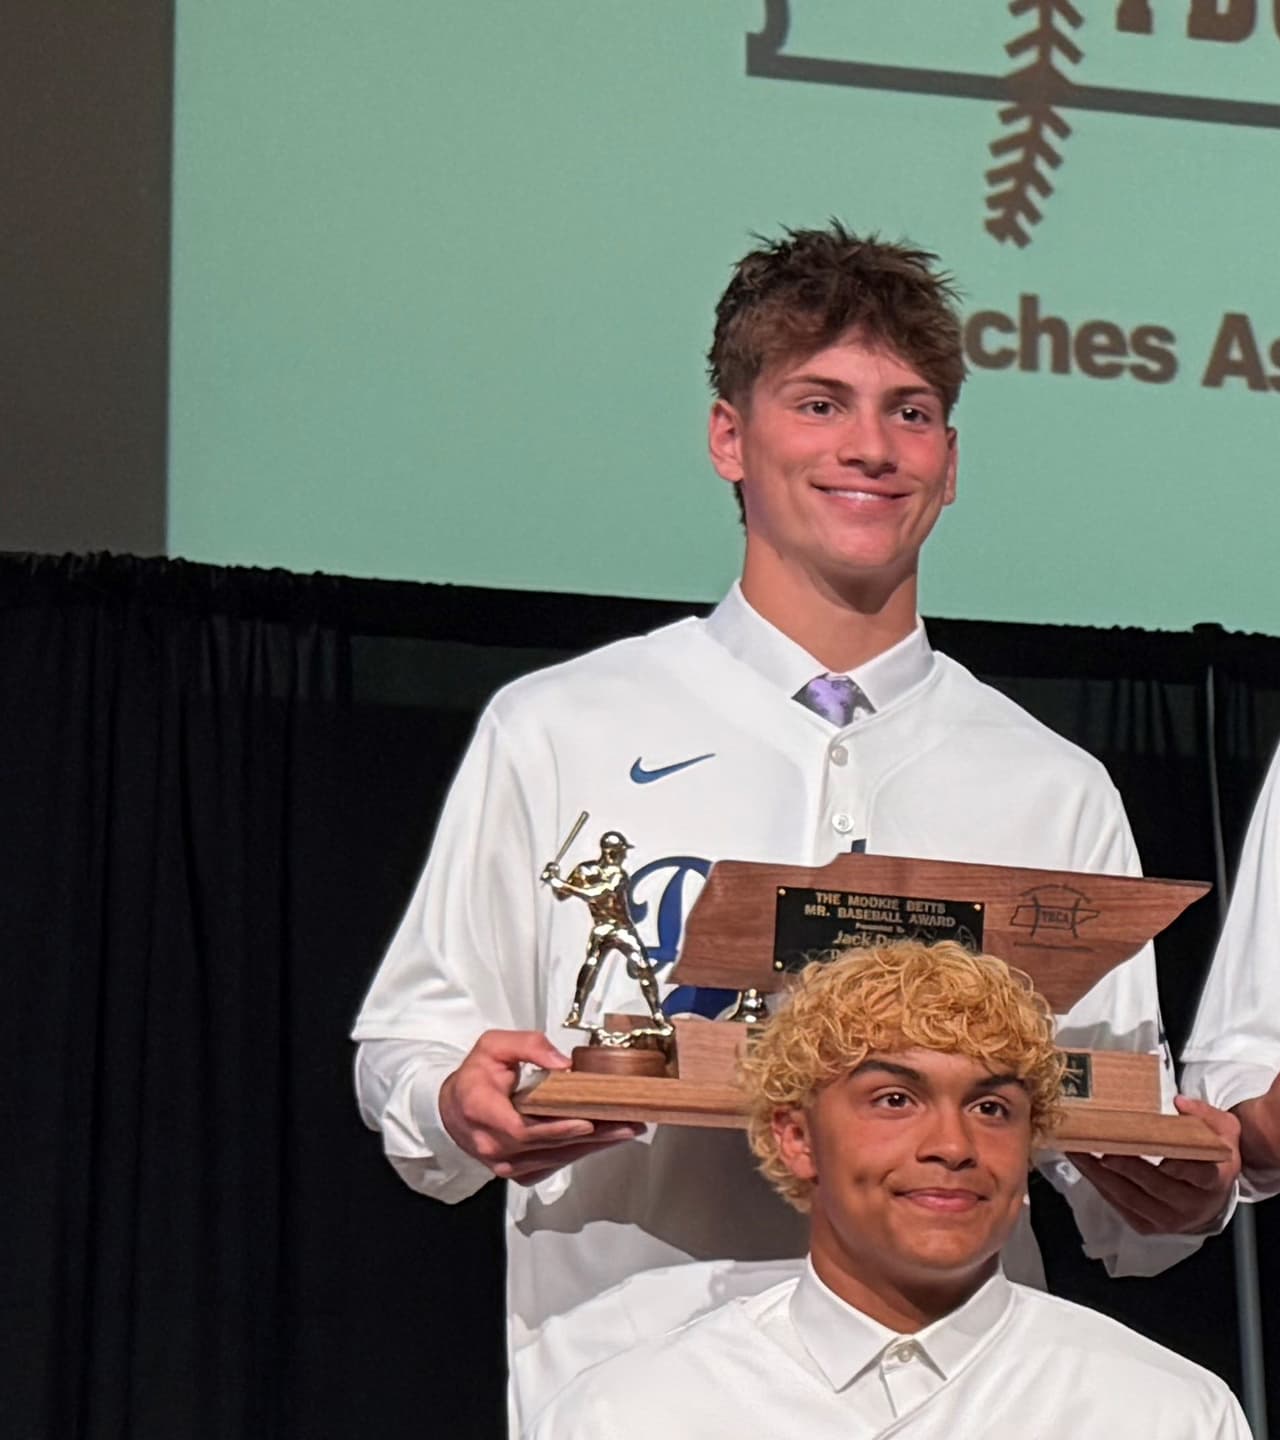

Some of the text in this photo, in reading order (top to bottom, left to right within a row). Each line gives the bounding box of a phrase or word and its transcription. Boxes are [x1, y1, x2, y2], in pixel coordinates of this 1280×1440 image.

[963, 293, 1178, 383] ches
[816, 892, 946, 914] THE MOOKIE BETTS
[805, 905, 955, 927] MR. BASEBALL AWARD
[833, 930, 870, 946] Jack
